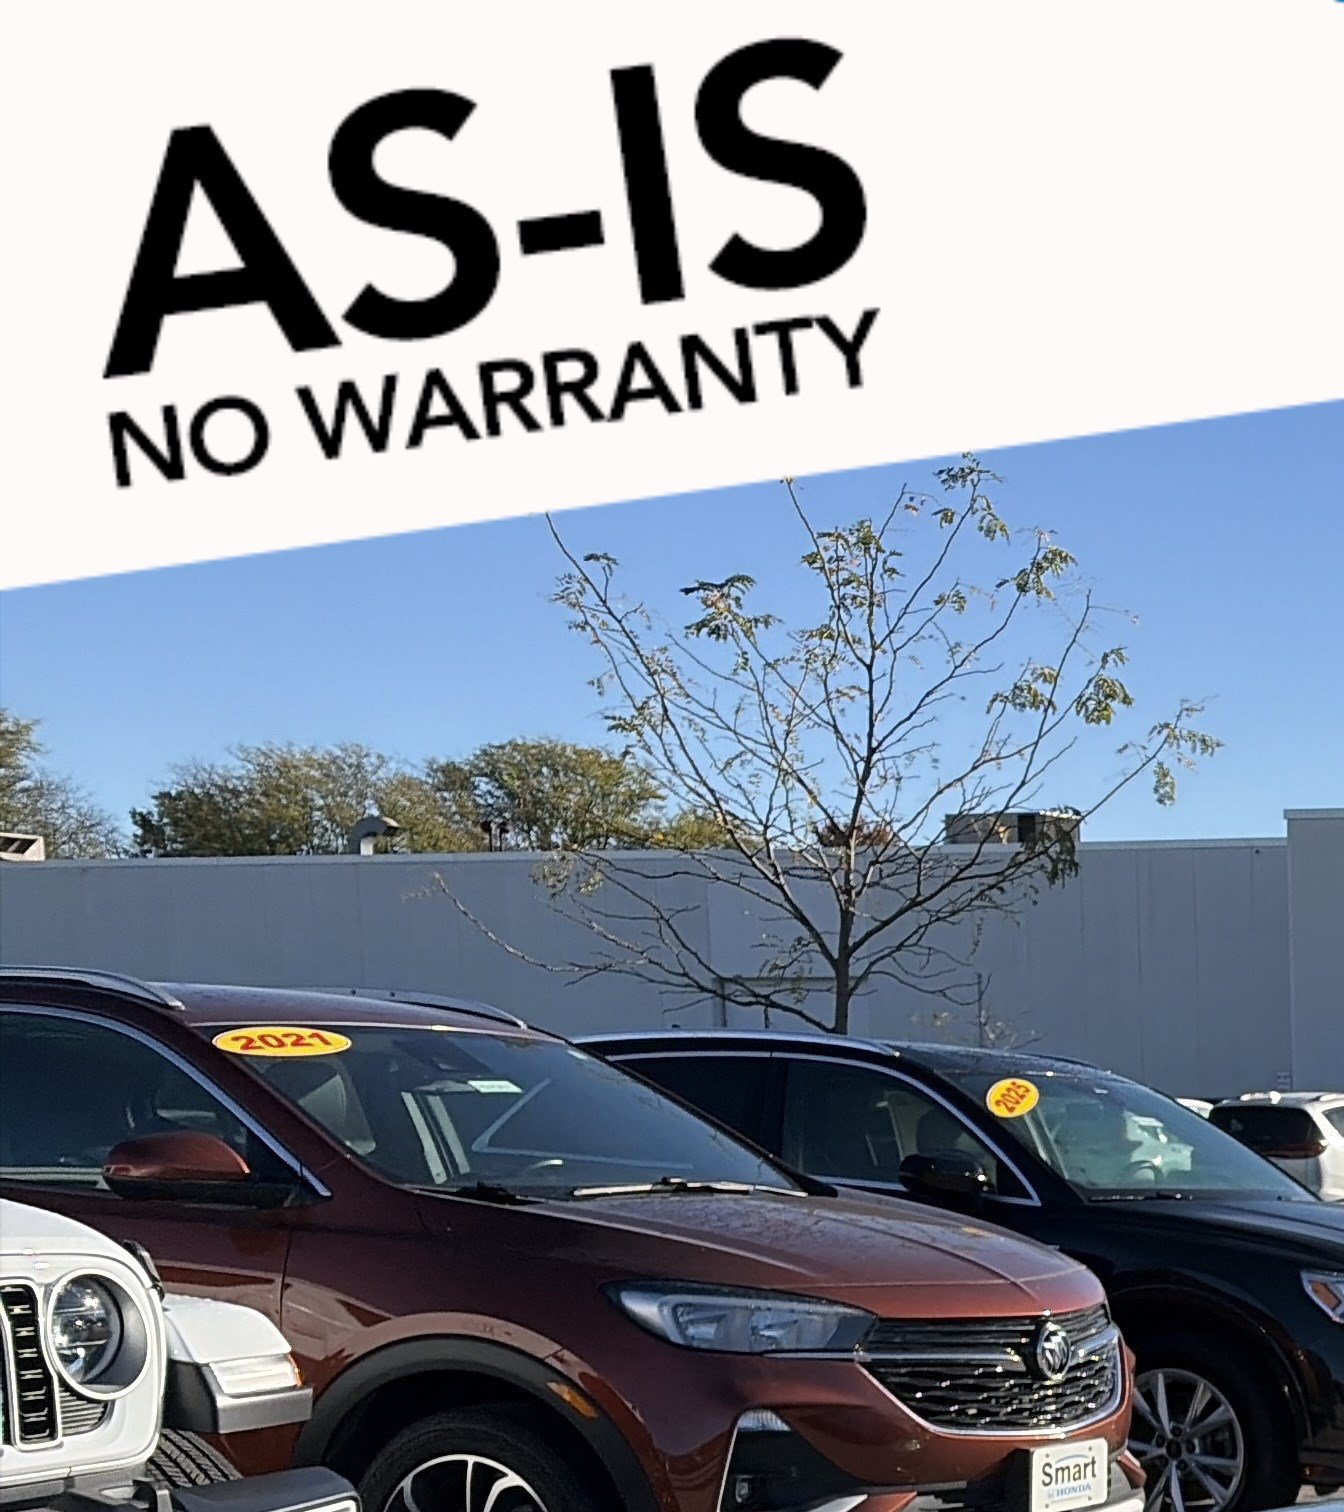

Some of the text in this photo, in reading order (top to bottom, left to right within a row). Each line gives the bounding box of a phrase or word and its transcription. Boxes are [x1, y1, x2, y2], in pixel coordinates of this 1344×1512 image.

[231, 1032, 334, 1051] 2021
[994, 1081, 1030, 1113] 2025
[1041, 1455, 1097, 1487] Smart
[1056, 1483, 1092, 1497] HONDA
